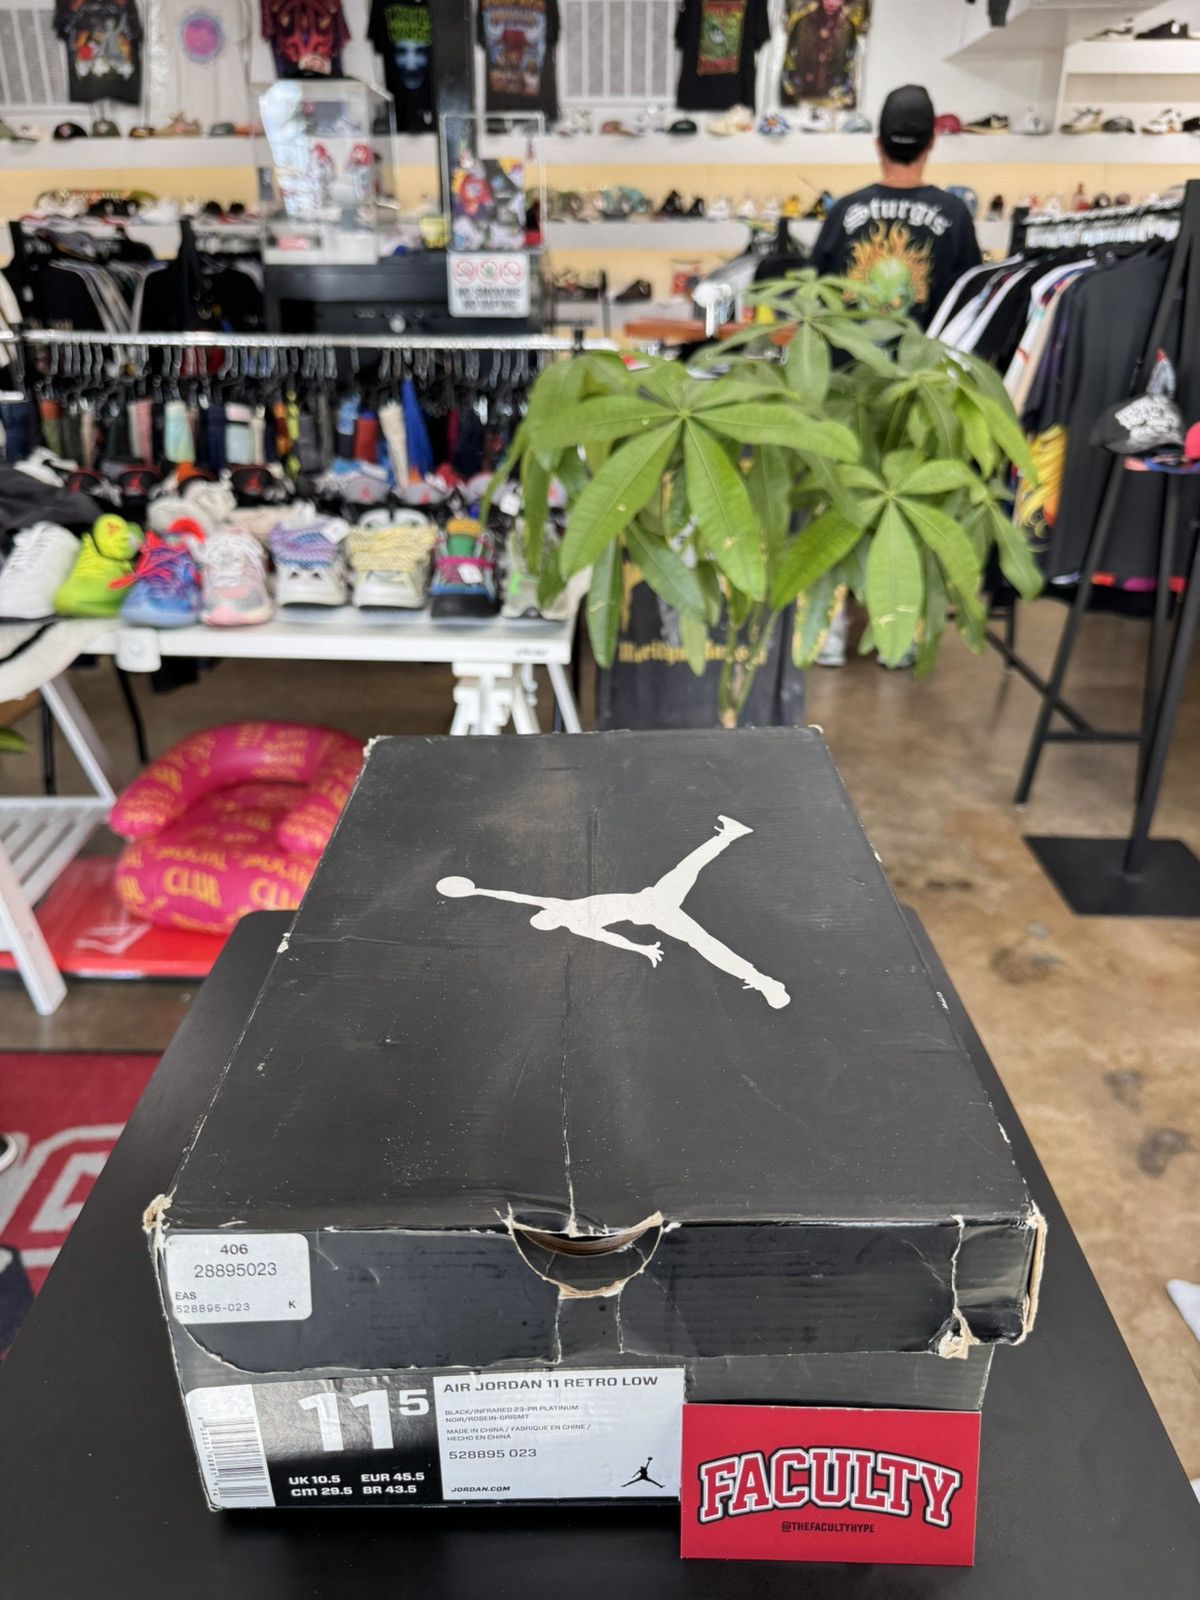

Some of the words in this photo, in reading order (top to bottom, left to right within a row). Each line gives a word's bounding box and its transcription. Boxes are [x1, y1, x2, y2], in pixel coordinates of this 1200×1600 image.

[843, 197, 952, 235] Sturgis
[220, 1243, 249, 1255] 406
[194, 1262, 277, 1278] 28895023
[175, 1291, 197, 1300] EAS
[176, 1302, 250, 1313] 528895-023
[288, 1300, 297, 1309] K
[444, 1383, 471, 1393] AIR
[475, 1380, 542, 1391] JORDAN
[547, 1378, 559, 1389] 11
[564, 1377, 617, 1387] RETRO
[622, 1376, 658, 1386] LOW
[449, 1449, 505, 1459] 528895
[508, 1448, 537, 1458] 023
[288, 1476, 309, 1485] UK
[312, 1475, 341, 1484] 10.5
[361, 1473, 391, 1482] EUR
[321, 1486, 353, 1495] 29.5
[362, 1486, 382, 1494] BR
[385, 1485, 417, 1493] 43.5
[451, 1485, 511, 1493] JORDAN.COM
[698, 1446, 962, 1528] FACULTY
[781, 1521, 875, 1534] @THEFACULTYHYPE
